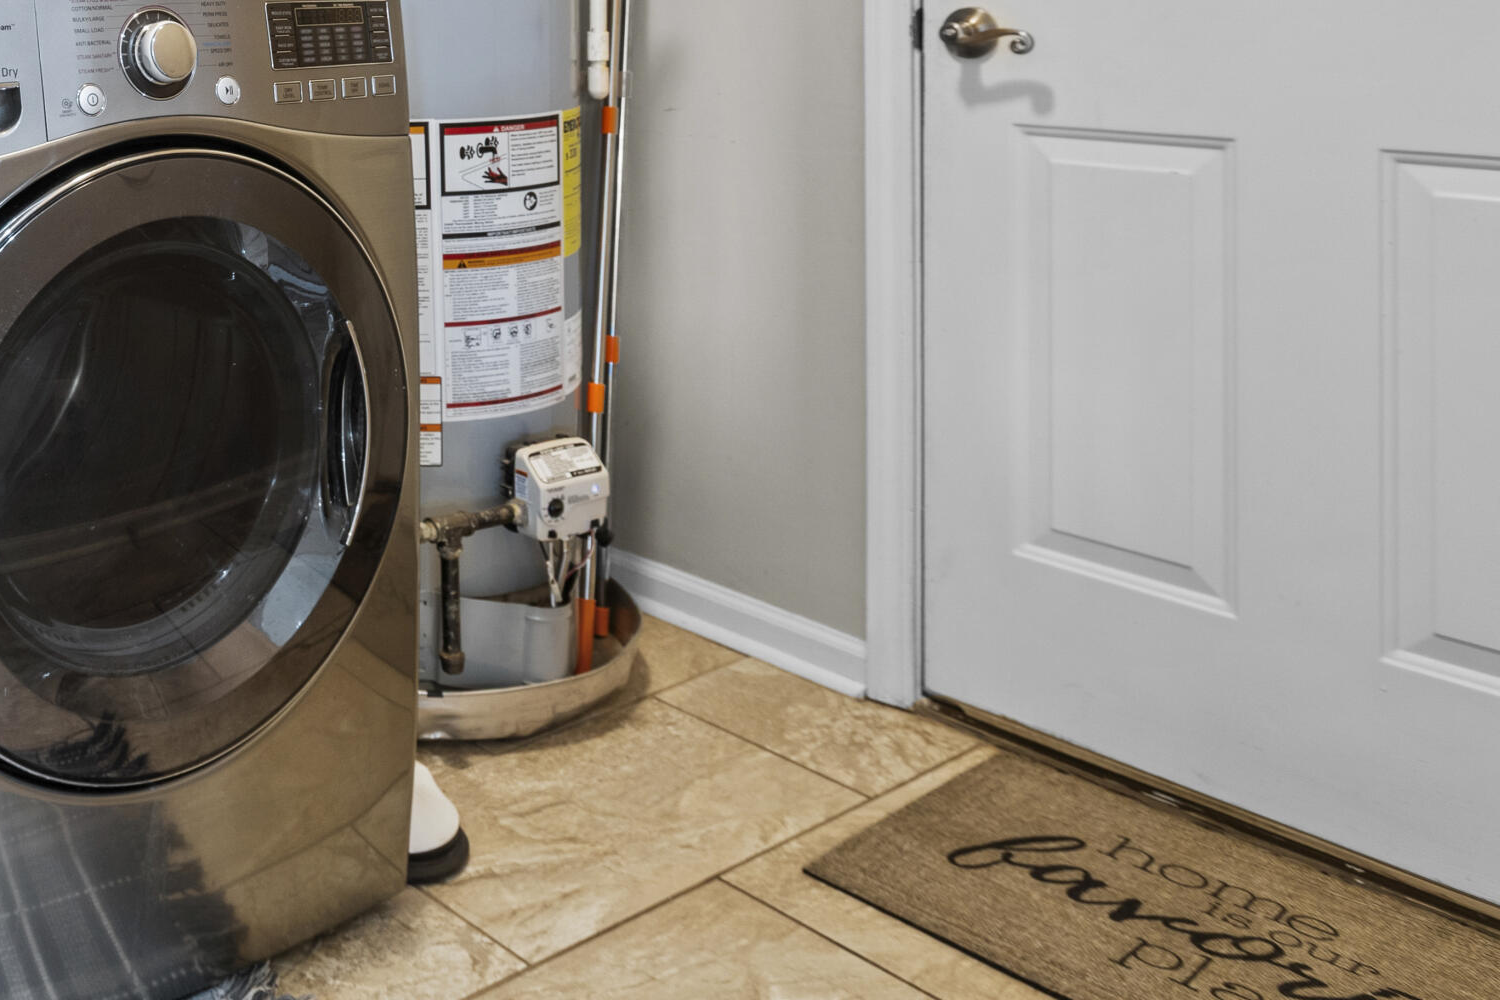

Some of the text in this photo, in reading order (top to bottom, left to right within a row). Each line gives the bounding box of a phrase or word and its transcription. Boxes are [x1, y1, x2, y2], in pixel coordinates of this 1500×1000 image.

[2, 67, 19, 79] Dry
[501, 123, 525, 132] DANGER
[1096, 834, 1340, 942] home
[1199, 901, 1254, 930] is
[1269, 930, 1381, 976] our
